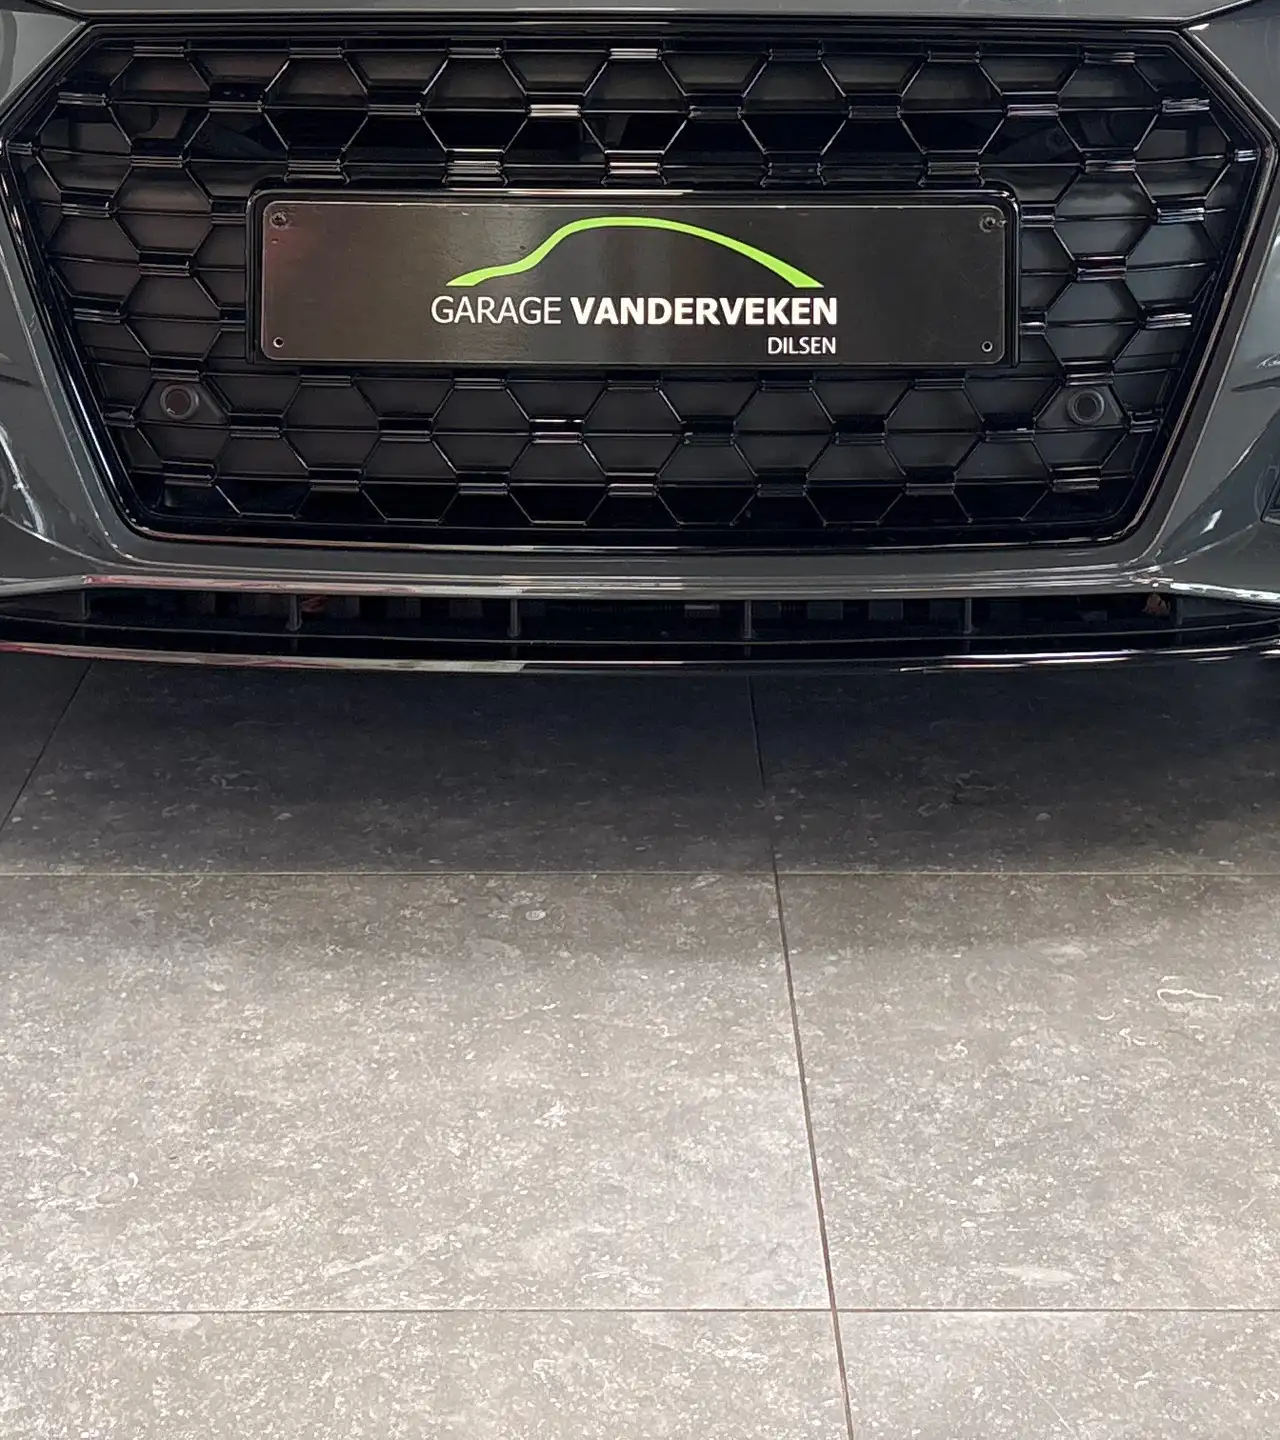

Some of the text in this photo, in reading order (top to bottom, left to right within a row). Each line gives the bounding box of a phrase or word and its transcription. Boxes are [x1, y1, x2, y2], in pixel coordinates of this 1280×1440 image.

[430, 295, 838, 326] GARAGE VANDERVEKEN
[766, 336, 837, 355] DILSEN
